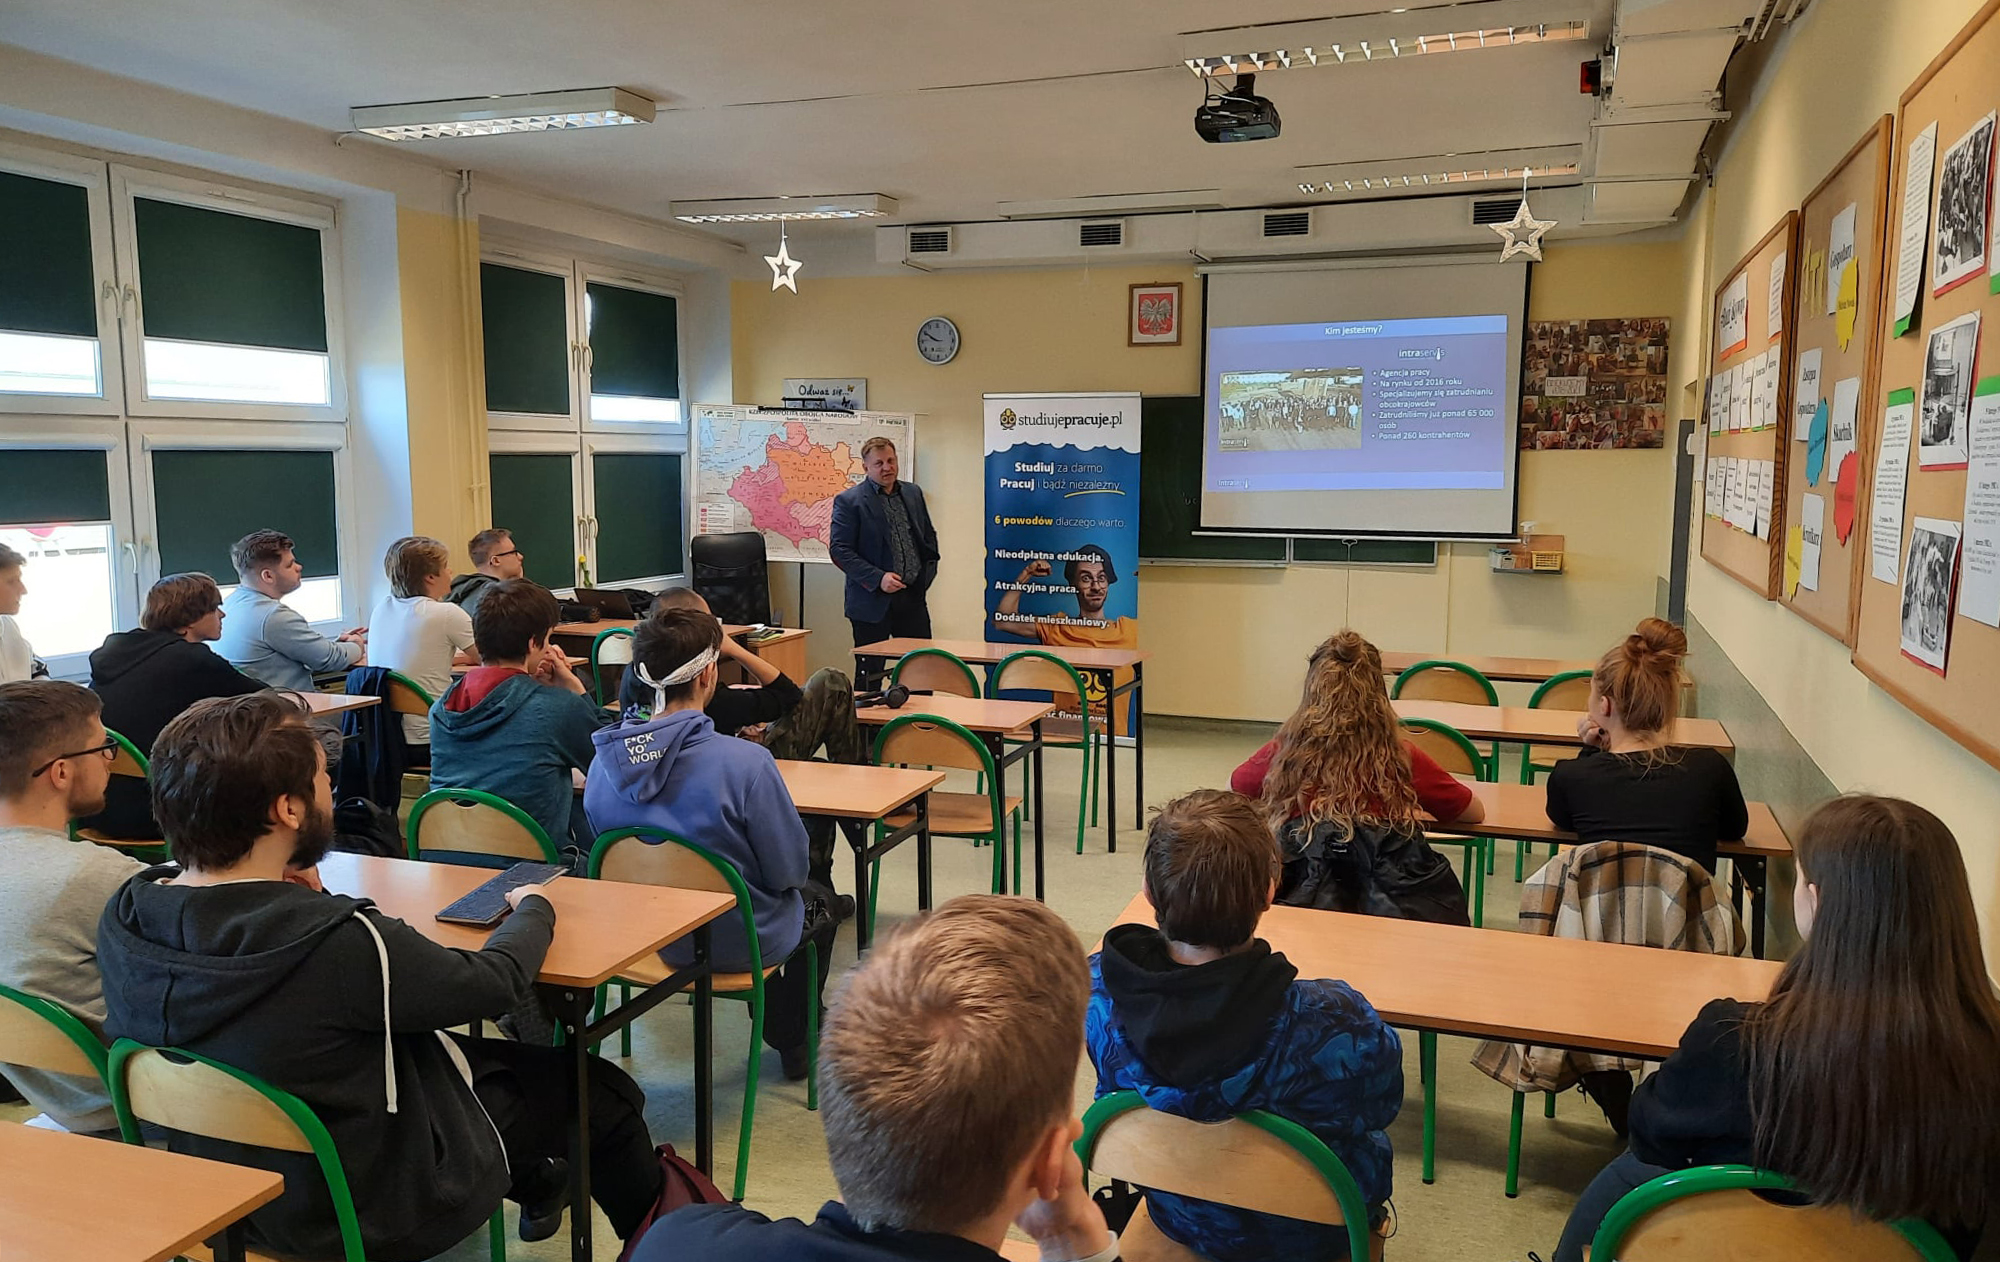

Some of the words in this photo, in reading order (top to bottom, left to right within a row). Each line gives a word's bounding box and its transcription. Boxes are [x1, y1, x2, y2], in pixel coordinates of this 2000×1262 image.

[1325, 327, 1341, 335] Kim
[1341, 324, 1383, 336] jesteśmy?
[1379, 369, 1409, 379] Agencja
[1410, 369, 1431, 378] pracy
[1391, 379, 1412, 388] rynku
[1414, 378, 1424, 386] od
[1426, 378, 1443, 386] 2016
[1445, 377, 1462, 385] roku
[1379, 389, 1433, 399] Specjalizujemy
[1446, 388, 1494, 396] zatrudnianiu
[1441, 409, 1466, 418] ponad
[1467, 409, 1478, 417] 65
[1479, 409, 1494, 417] 000
[1018, 411, 1122, 429] studiujepracuje.pl
[1378, 421, 1397, 429] osób
[1378, 432, 1401, 440] Ponad
[1403, 431, 1417, 439] 260
[1418, 430, 1471, 439] kontrahentów
[1014, 461, 1055, 475] Studiuj
[1057, 464, 1068, 473] za
[1070, 462, 1103, 474] darmo
[999, 478, 1035, 491] Pracuj
[994, 515, 1001, 524] 6
[1003, 515, 1053, 527] powodów
[1055, 516, 1096, 528] dlaczego
[994, 549, 1055, 561] Nieodpłatna
[1057, 551, 1104, 563] edukacja.
[994, 581, 1047, 594] Atrakcyjna
[1049, 584, 1080, 594] praca.
[994, 612, 1035, 623] Dodatek
[1037, 615, 1110, 629] mieszkaniowy.
